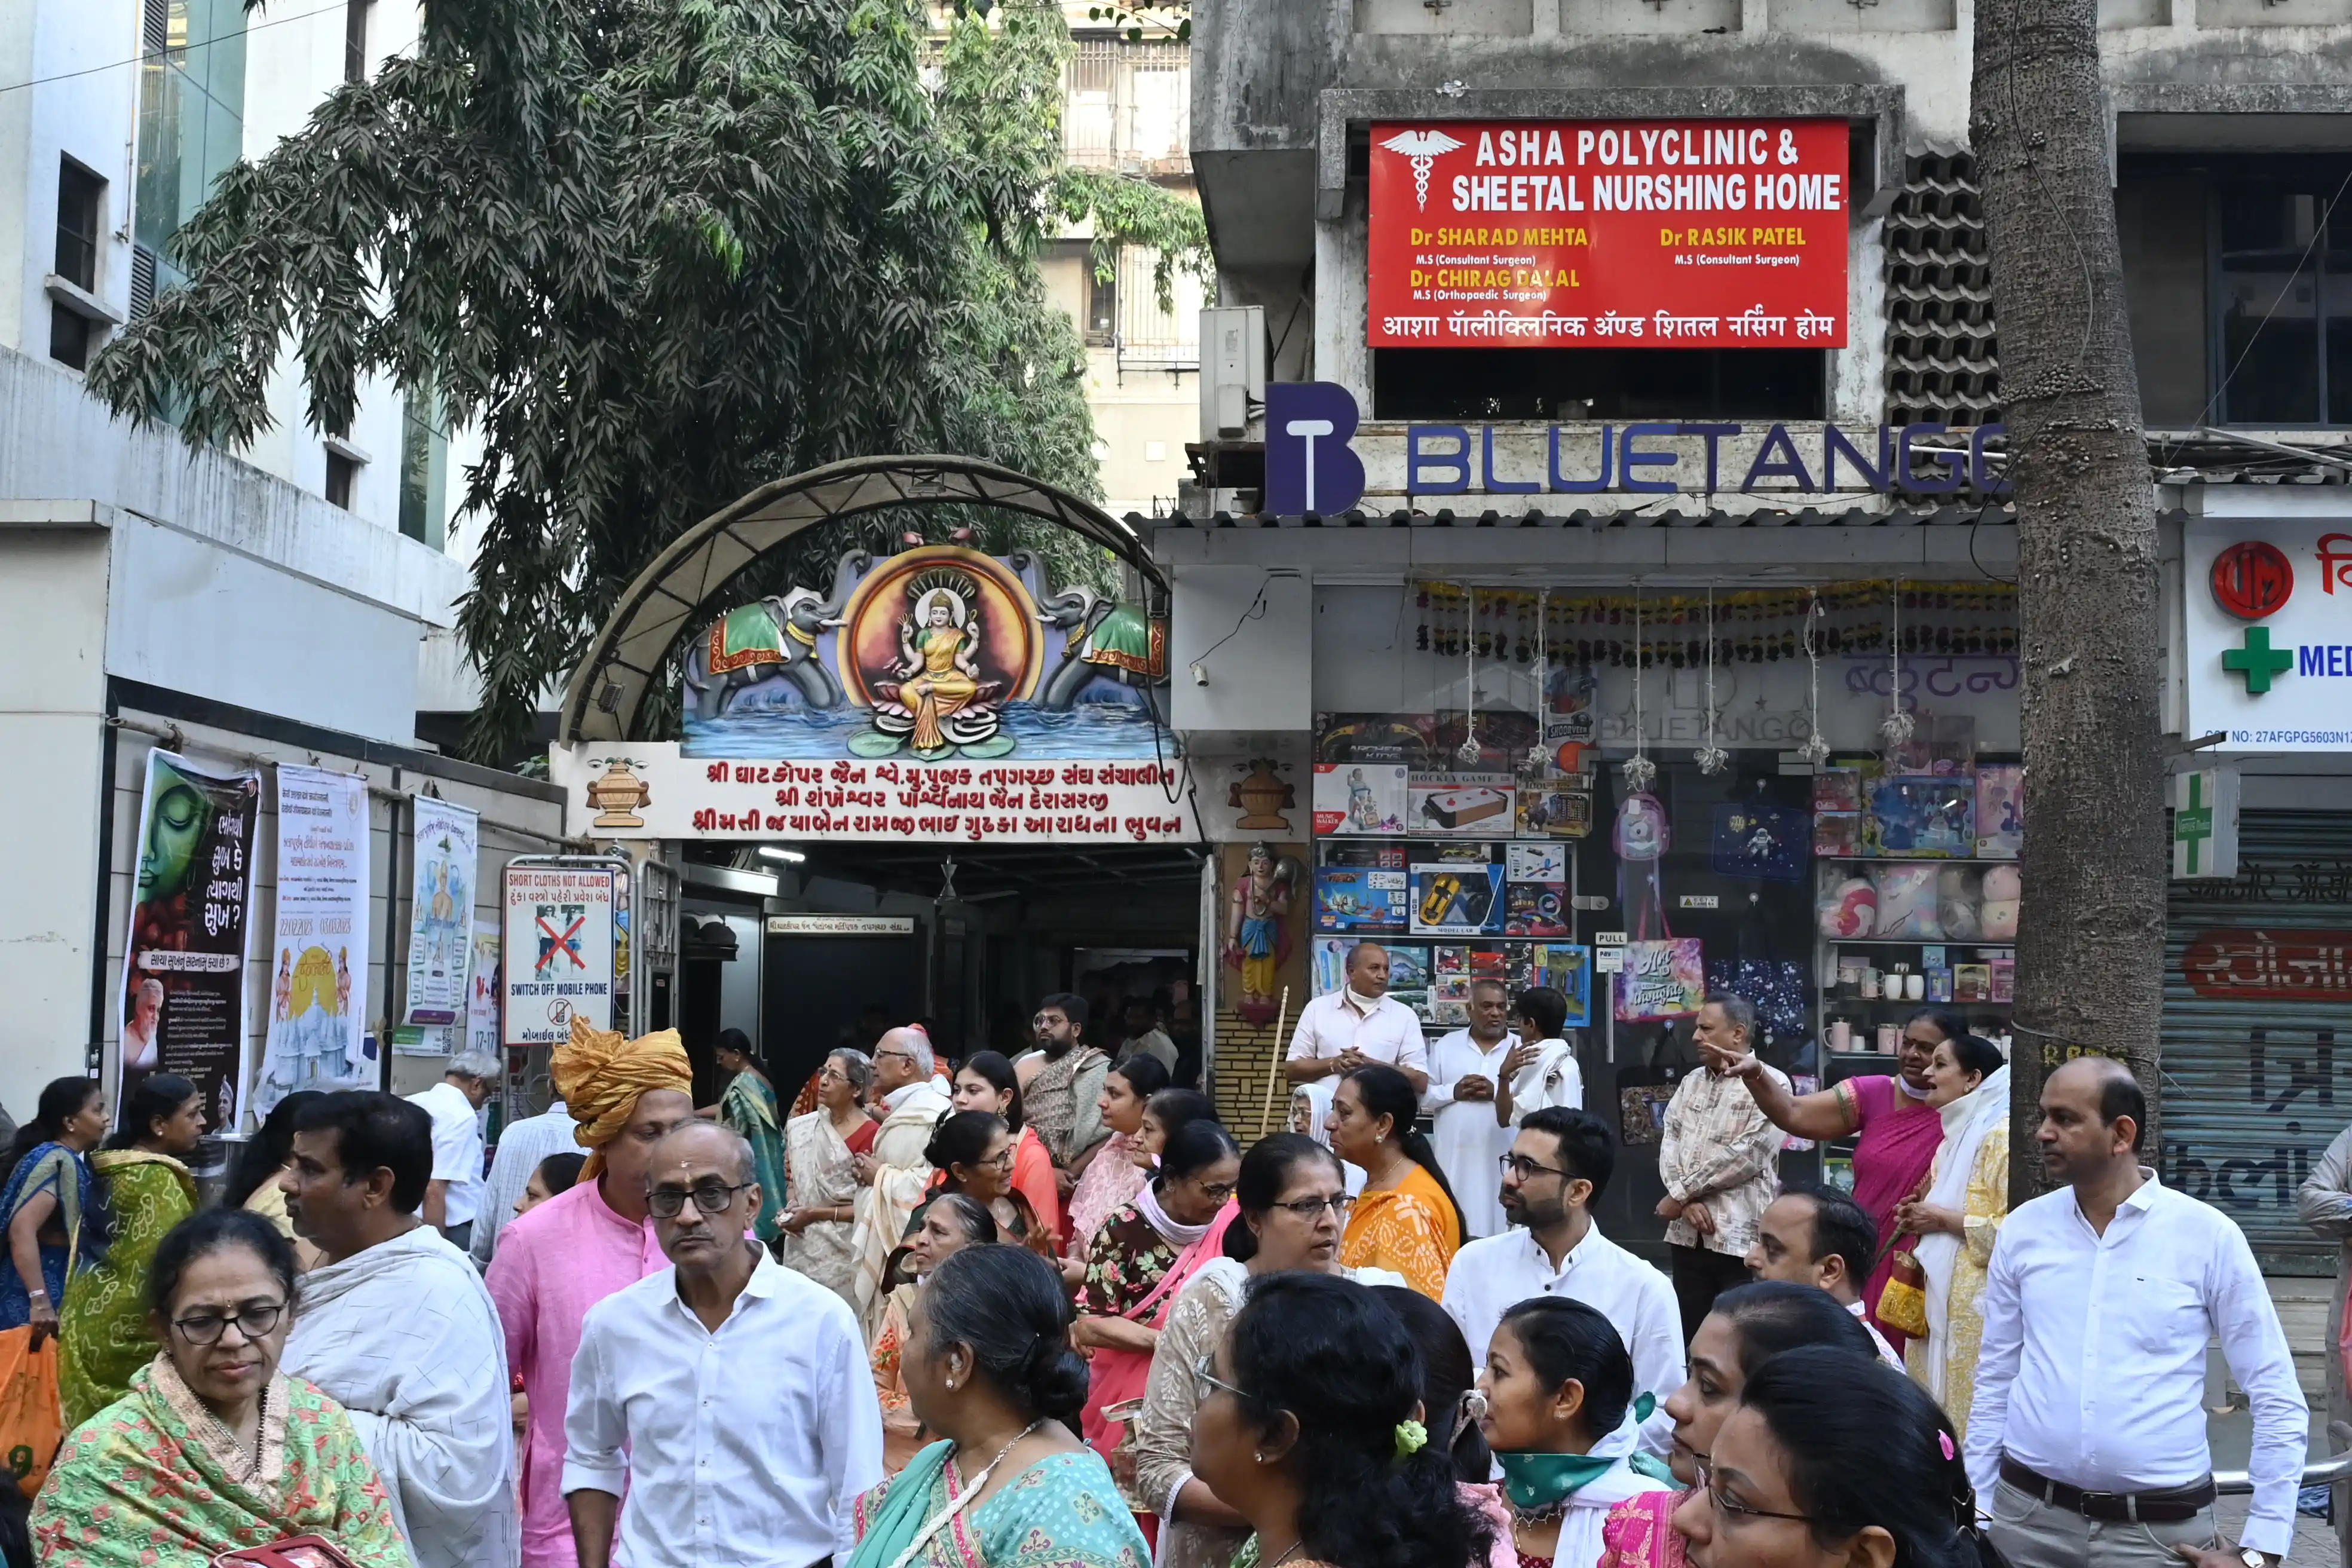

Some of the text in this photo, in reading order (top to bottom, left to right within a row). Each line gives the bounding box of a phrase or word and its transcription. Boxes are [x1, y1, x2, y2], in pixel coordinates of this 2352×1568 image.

[1477, 130, 1799, 167] ASHA POLYCLINIC &
[1453, 174, 1840, 212] SHEETAL NURSHING HOME
[1412, 229, 1588, 246] Dr SHARAD MEHTA
[1662, 228, 1806, 246] Dr RASIK PATEL
[1417, 254, 1537, 268] M.S (Consultant Surgeon)
[1676, 254, 1800, 267] M.S (Consultant Surgeon)
[1411, 269, 1579, 289] Dr CHIRAG DALAL
[1414, 289, 1548, 304] M.S (Orthopaedic Surgeon)
[1383, 317, 1441, 338] आशा
[1653, 310, 1720, 338] शितल
[1727, 304, 1788, 337] नर्सिंग
[1795, 309, 1836, 340] होम
[2300, 645, 2352, 676] ME
[2232, 730, 2252, 742] NO:
[2256, 731, 2352, 743] 27AFGPG5603N1
[707, 761, 728, 783] શ્રી
[736, 761, 822, 784] ઘાટકોપર
[831, 761, 866, 784] જૈન
[979, 768, 1055, 785] તપગચ્છ
[1062, 763, 1094, 785] સંઘ
[776, 785, 799, 807] શ્રી
[805, 785, 886, 808] શંખેશ્વર
[990, 788, 1023, 809] જૈન
[1030, 787, 1109, 811] દેરાસરજી
[693, 807, 760, 831] શ્રીમતી
[766, 808, 849, 833] જયાબેન
[1124, 816, 1181, 841] ભુવન
[212, 840, 242, 875] સુખ કે
[509, 874, 610, 888] SHORT CLOTHS NOT ALLOWED
[595, 890, 609, 903] બંધ
[205, 902, 229, 936] સુખ
[511, 983, 607, 996] SWITCH OFF MOBILE PHONE
[522, 1028, 554, 1041] મોબાઈલ
